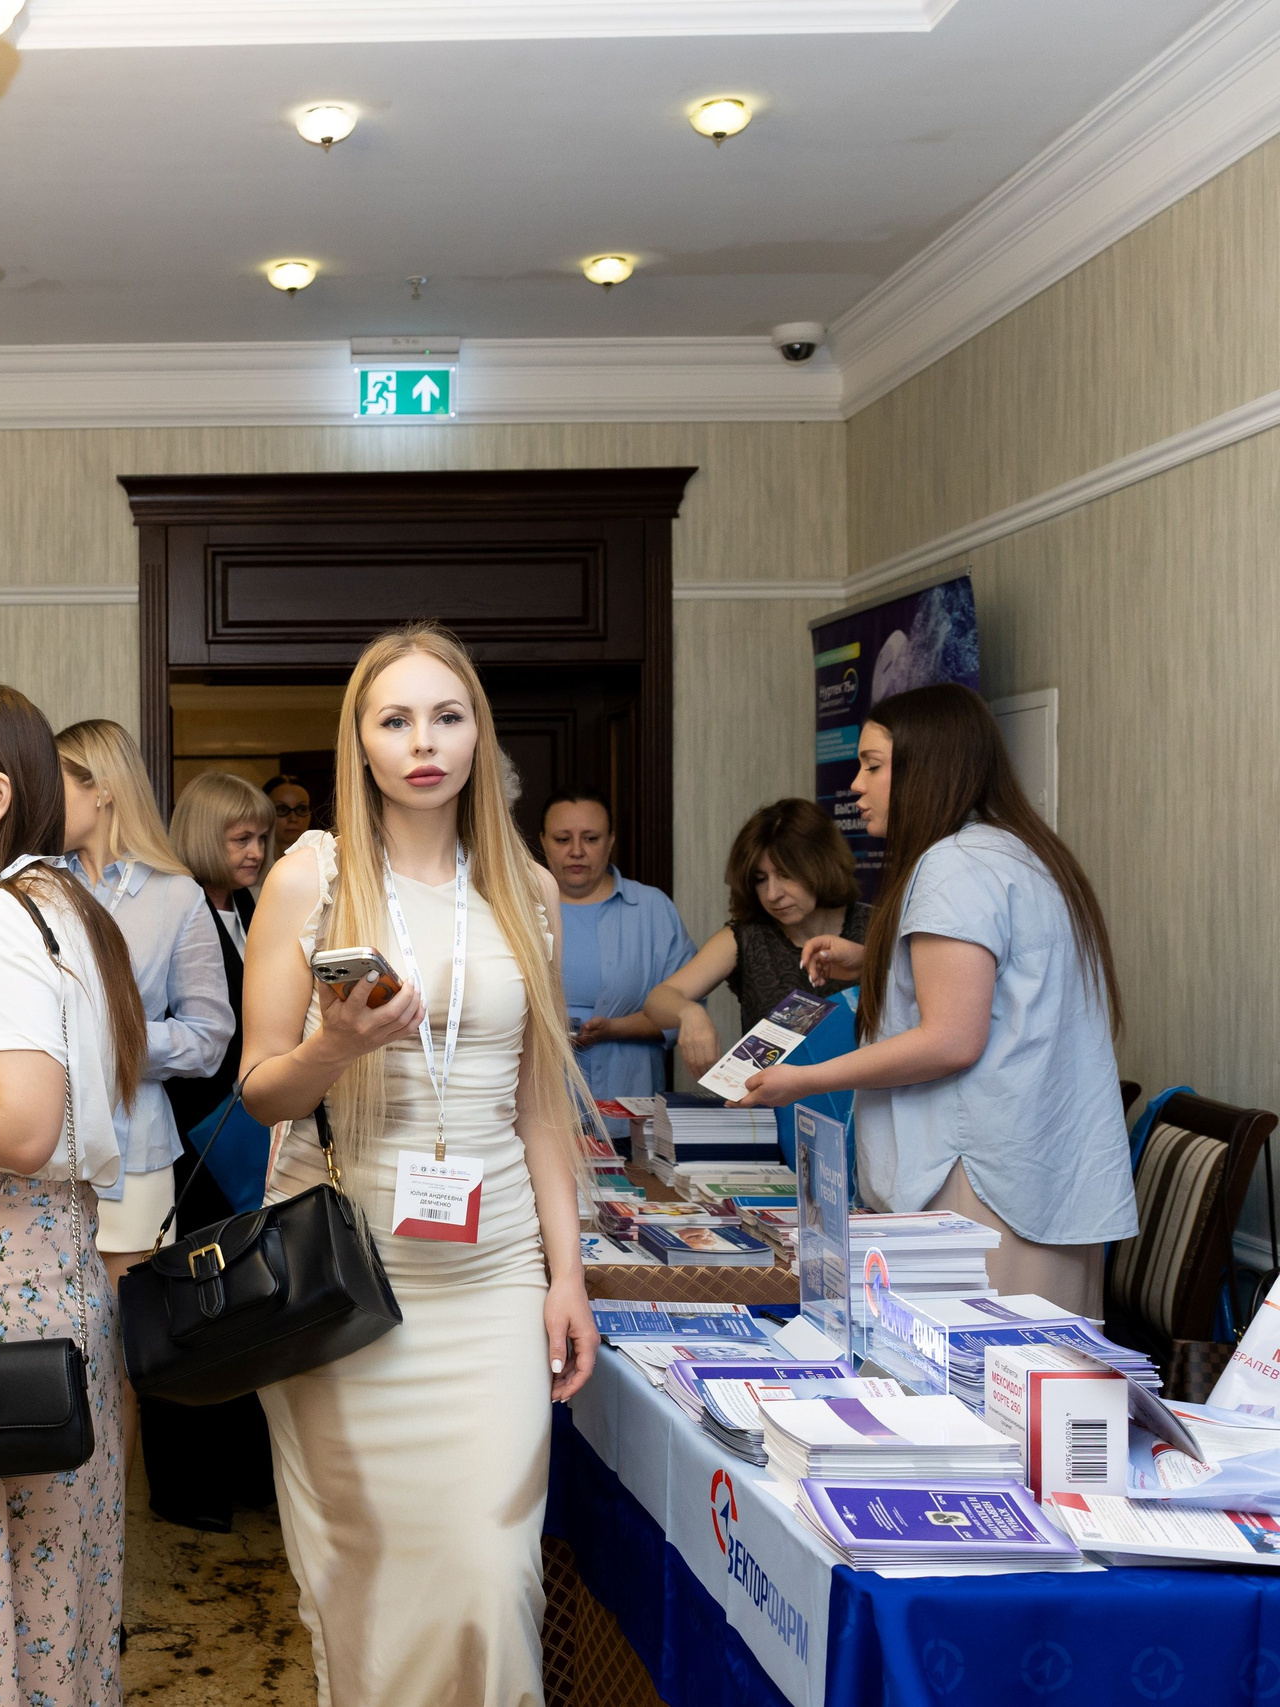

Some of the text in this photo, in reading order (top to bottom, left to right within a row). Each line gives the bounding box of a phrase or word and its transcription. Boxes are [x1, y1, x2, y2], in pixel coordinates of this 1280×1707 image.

[819, 1158, 843, 1188] Neuro
[419, 1199, 451, 1208] ДЕМЧЕНКО
[428, 1192, 463, 1202] АНДРЕЕВНА
[992, 1389, 1022, 1415] ФОРТЕ 250
